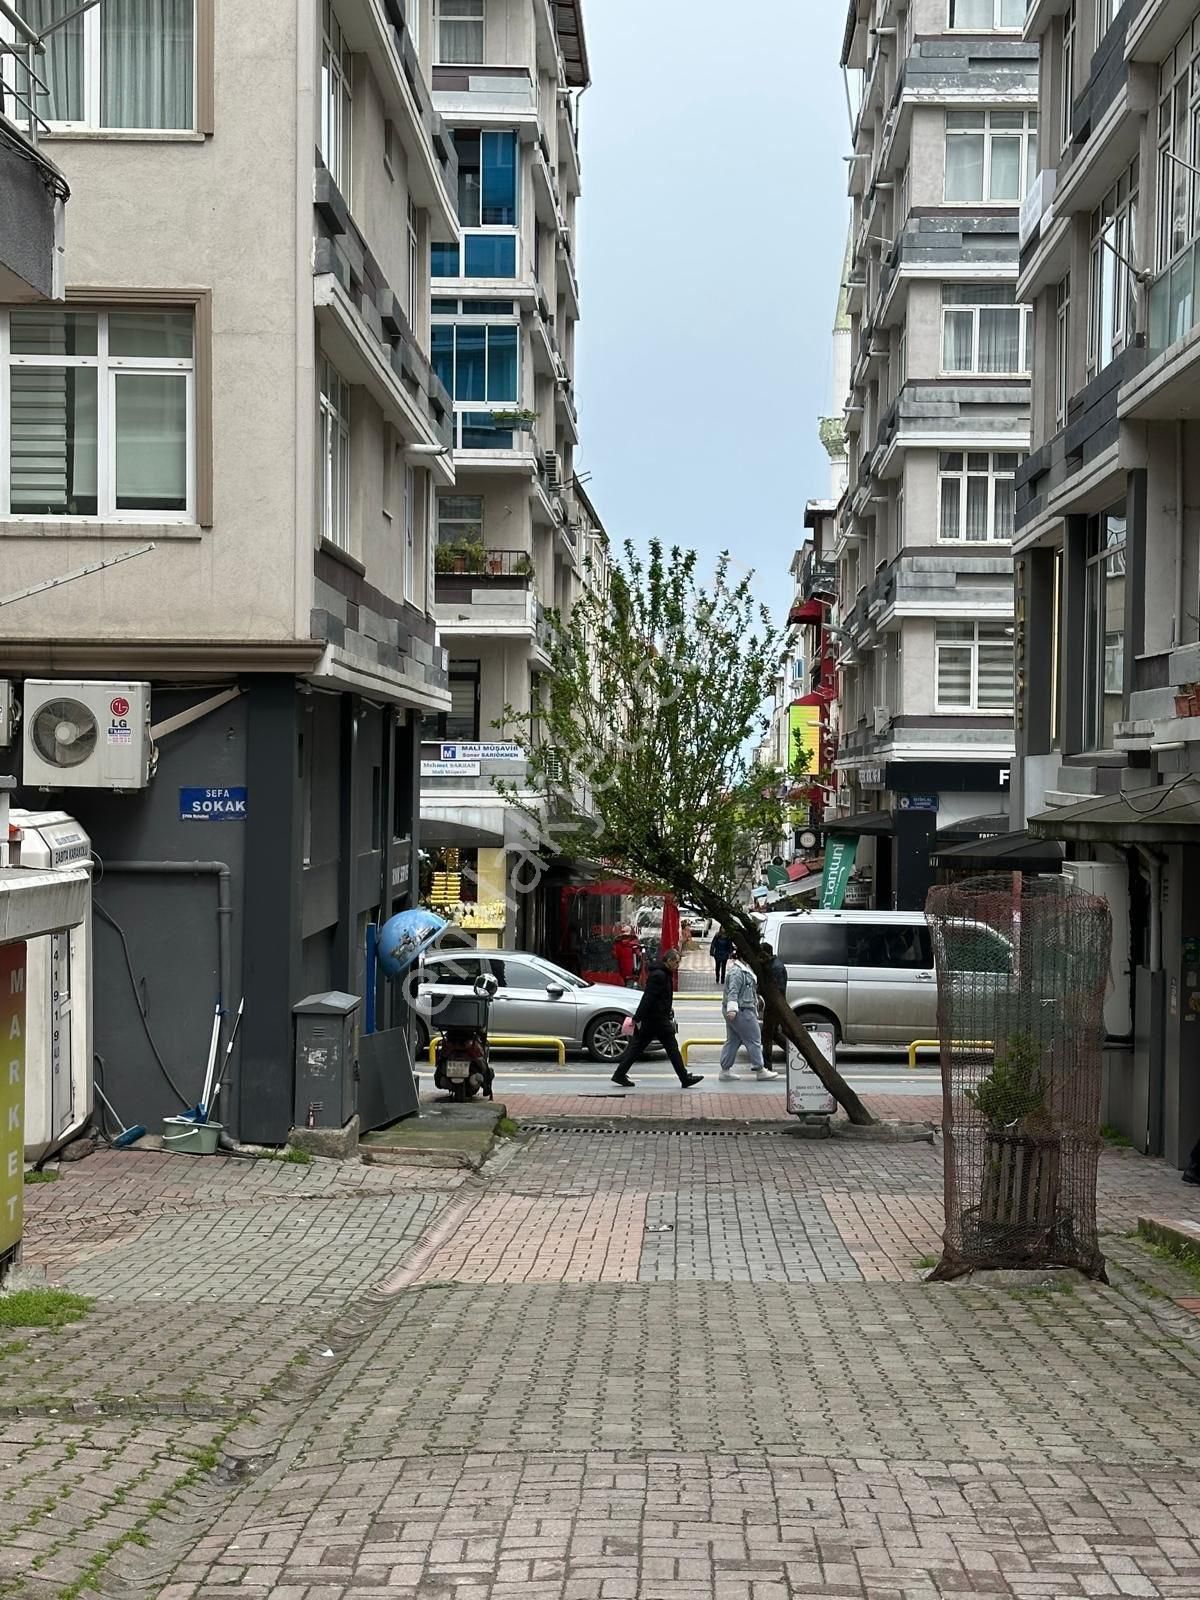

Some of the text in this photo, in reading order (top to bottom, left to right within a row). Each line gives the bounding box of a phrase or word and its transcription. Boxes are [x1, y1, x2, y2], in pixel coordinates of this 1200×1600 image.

[112, 719, 127, 728] LG
[206, 789, 230, 798] SEFA
[192, 801, 246, 812] SOKAK
[7, 967, 24, 1222] MARKET
